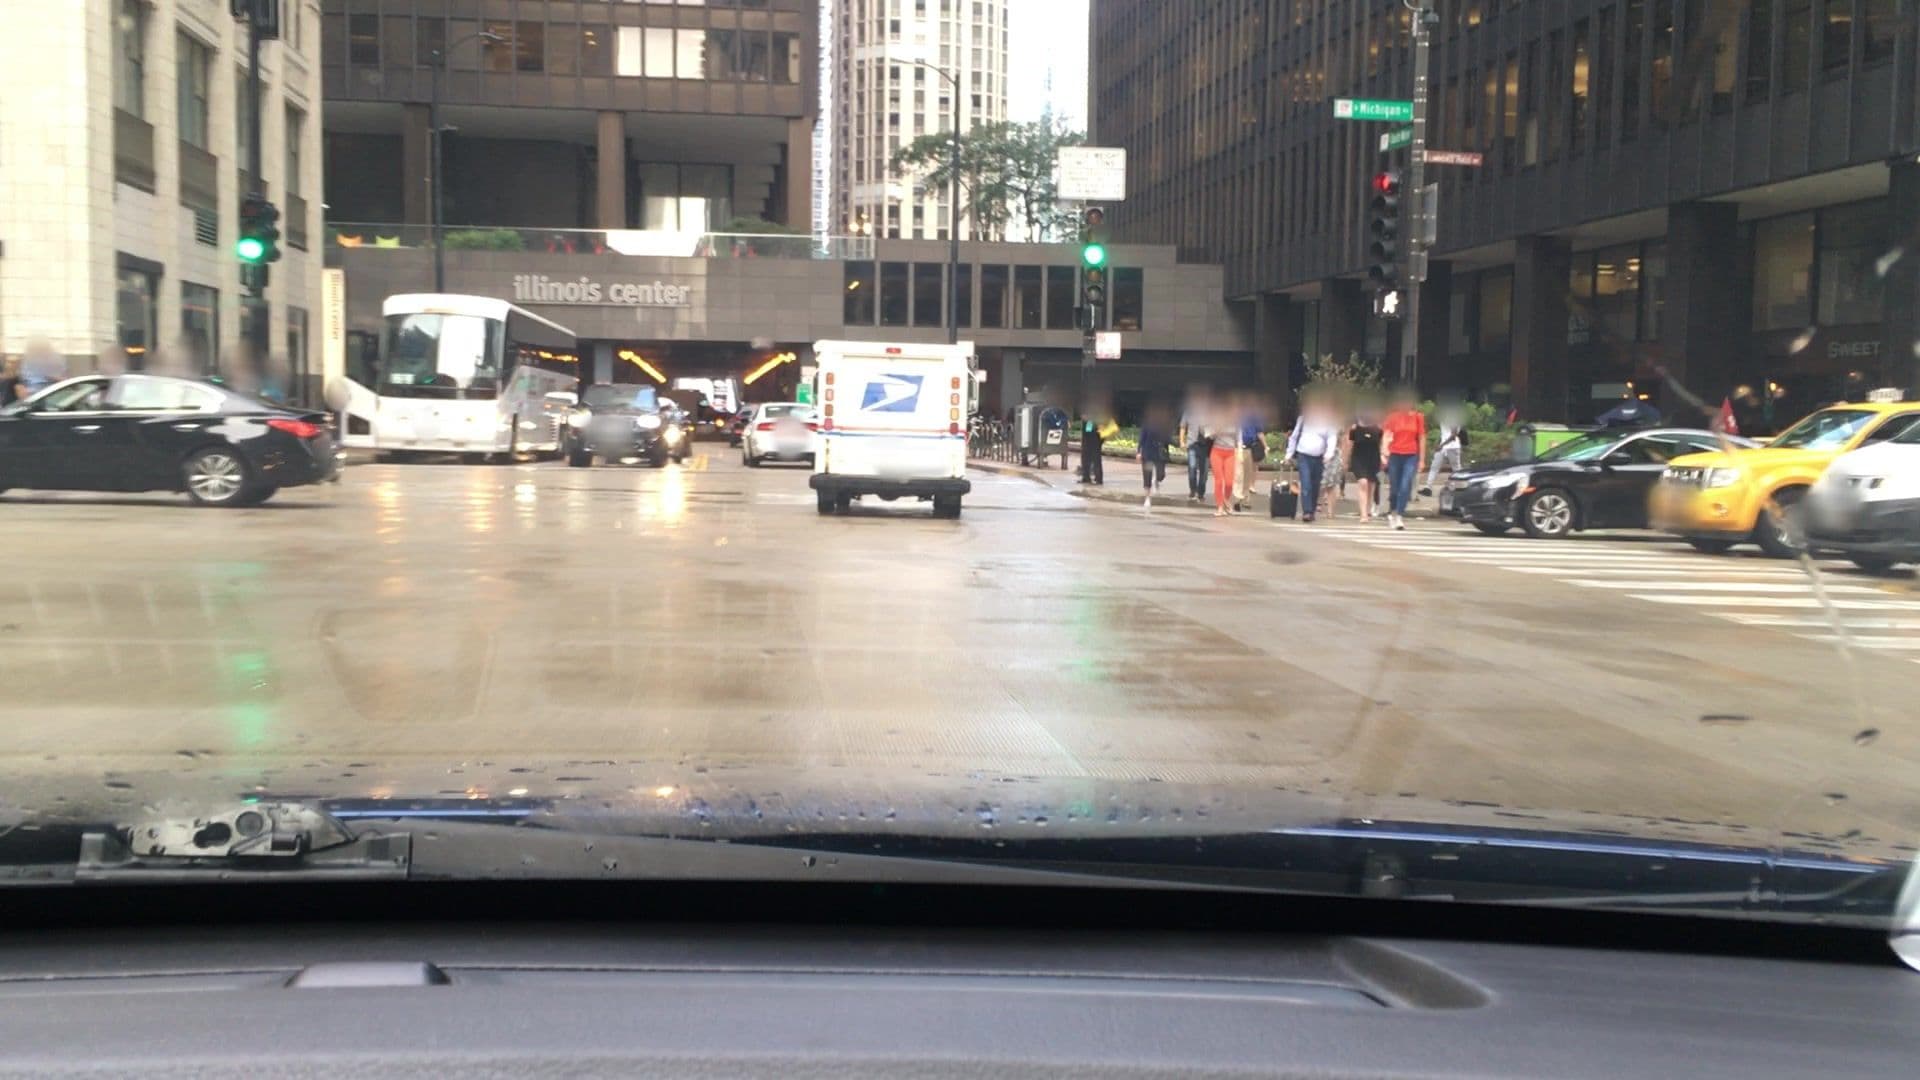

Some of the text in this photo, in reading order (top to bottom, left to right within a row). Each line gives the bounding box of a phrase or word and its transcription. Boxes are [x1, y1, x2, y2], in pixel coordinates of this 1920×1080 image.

[1360, 102, 1401, 119] Michigan
[512, 274, 691, 305] illinois center
[1827, 341, 1881, 358] SWEET
